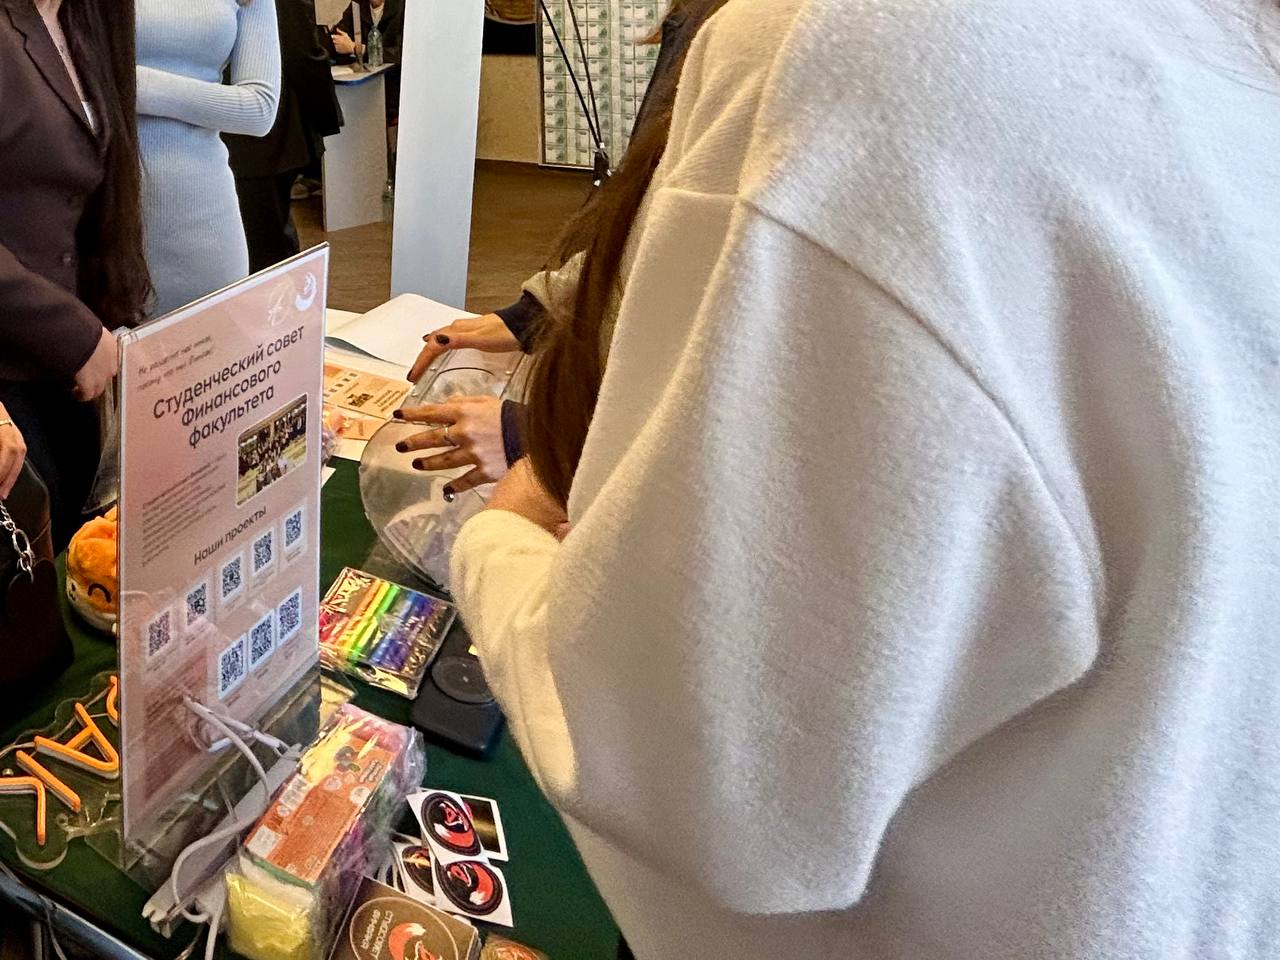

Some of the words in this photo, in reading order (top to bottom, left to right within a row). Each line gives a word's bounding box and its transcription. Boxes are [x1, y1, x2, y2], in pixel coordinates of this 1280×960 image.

[152, 343, 265, 419] Студенческий
[266, 325, 305, 357] совет
[181, 359, 282, 427] Финансового
[188, 385, 275, 449] факультета
[193, 536, 224, 566] Наши
[224, 505, 267, 543] проекты
